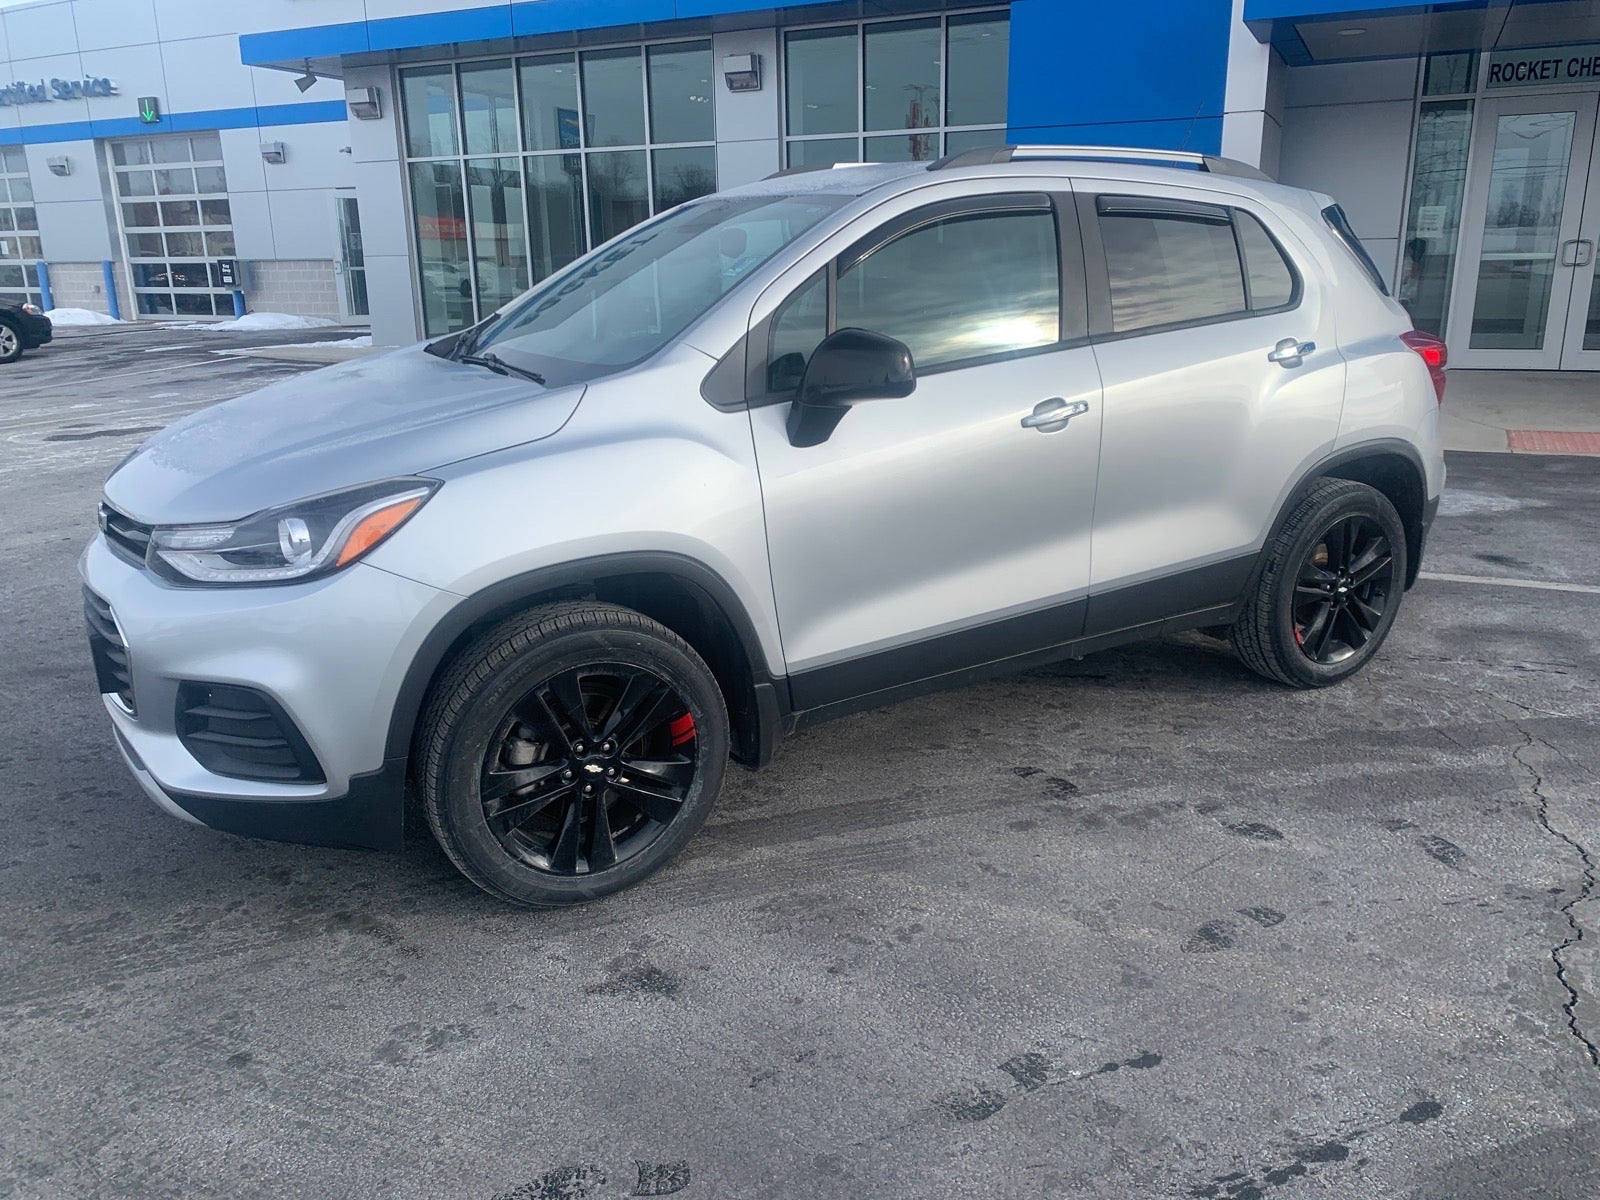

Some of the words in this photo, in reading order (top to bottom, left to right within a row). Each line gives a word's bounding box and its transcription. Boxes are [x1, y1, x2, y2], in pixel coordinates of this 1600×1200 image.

[1489, 59, 1563, 83] ROCKET
[1567, 56, 1600, 78] CHE
[51, 75, 113, 100] Service
